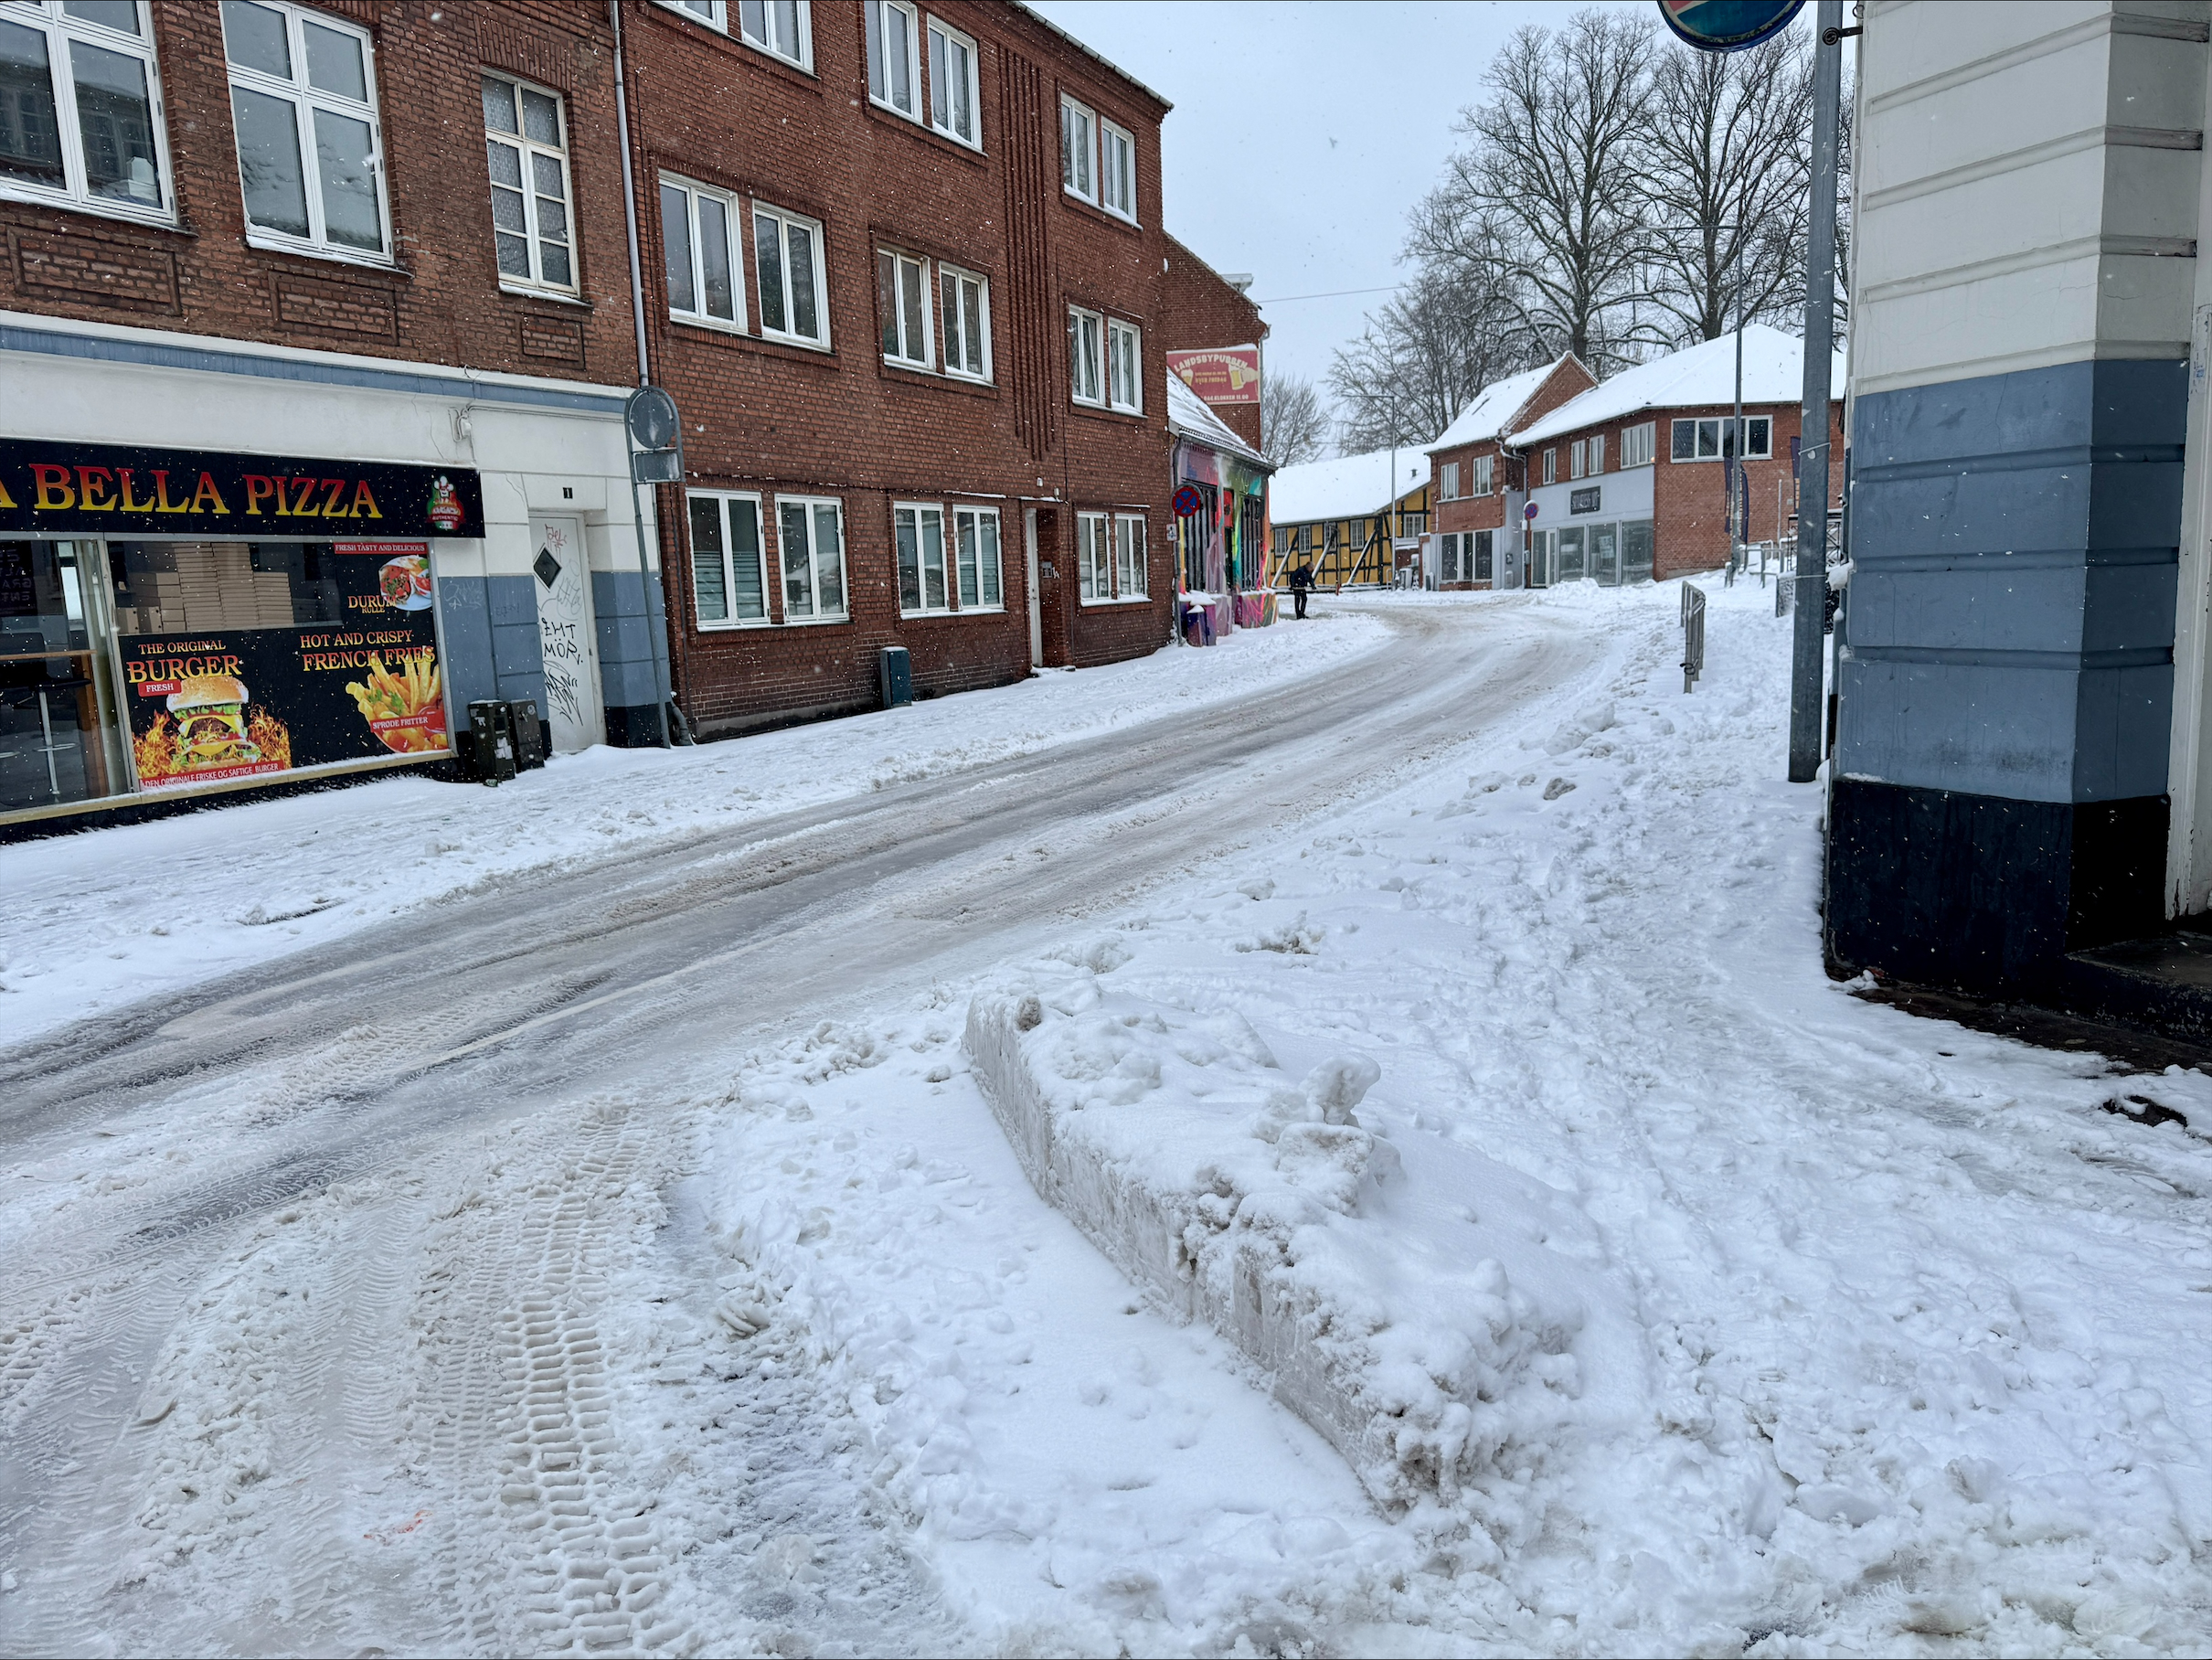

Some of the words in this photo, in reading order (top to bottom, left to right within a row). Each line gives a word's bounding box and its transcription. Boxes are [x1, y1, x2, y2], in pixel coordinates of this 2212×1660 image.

[1174, 354, 1249, 372] LANDSBYPUBBEN
[28, 463, 230, 514] BELLA
[241, 474, 383, 518] PIZZA
[347, 595, 397, 609] DURUM
[138, 643, 165, 654] THE
[167, 640, 227, 653] ORIGINAL
[300, 634, 330, 649] HOT
[334, 632, 364, 646] AND
[367, 630, 412, 644] CRISPY
[302, 649, 381, 672] FRENCH
[384, 645, 436, 665] FRIES
[126, 654, 242, 683] BURGER
[146, 683, 174, 692] FRESH
[400, 717, 428, 726] FRITTER
[196, 771, 218, 782] FRISKE
[218, 770, 228, 778] OG
[229, 766, 252, 777] SAFTIGE
[255, 762, 278, 772] BURGER
